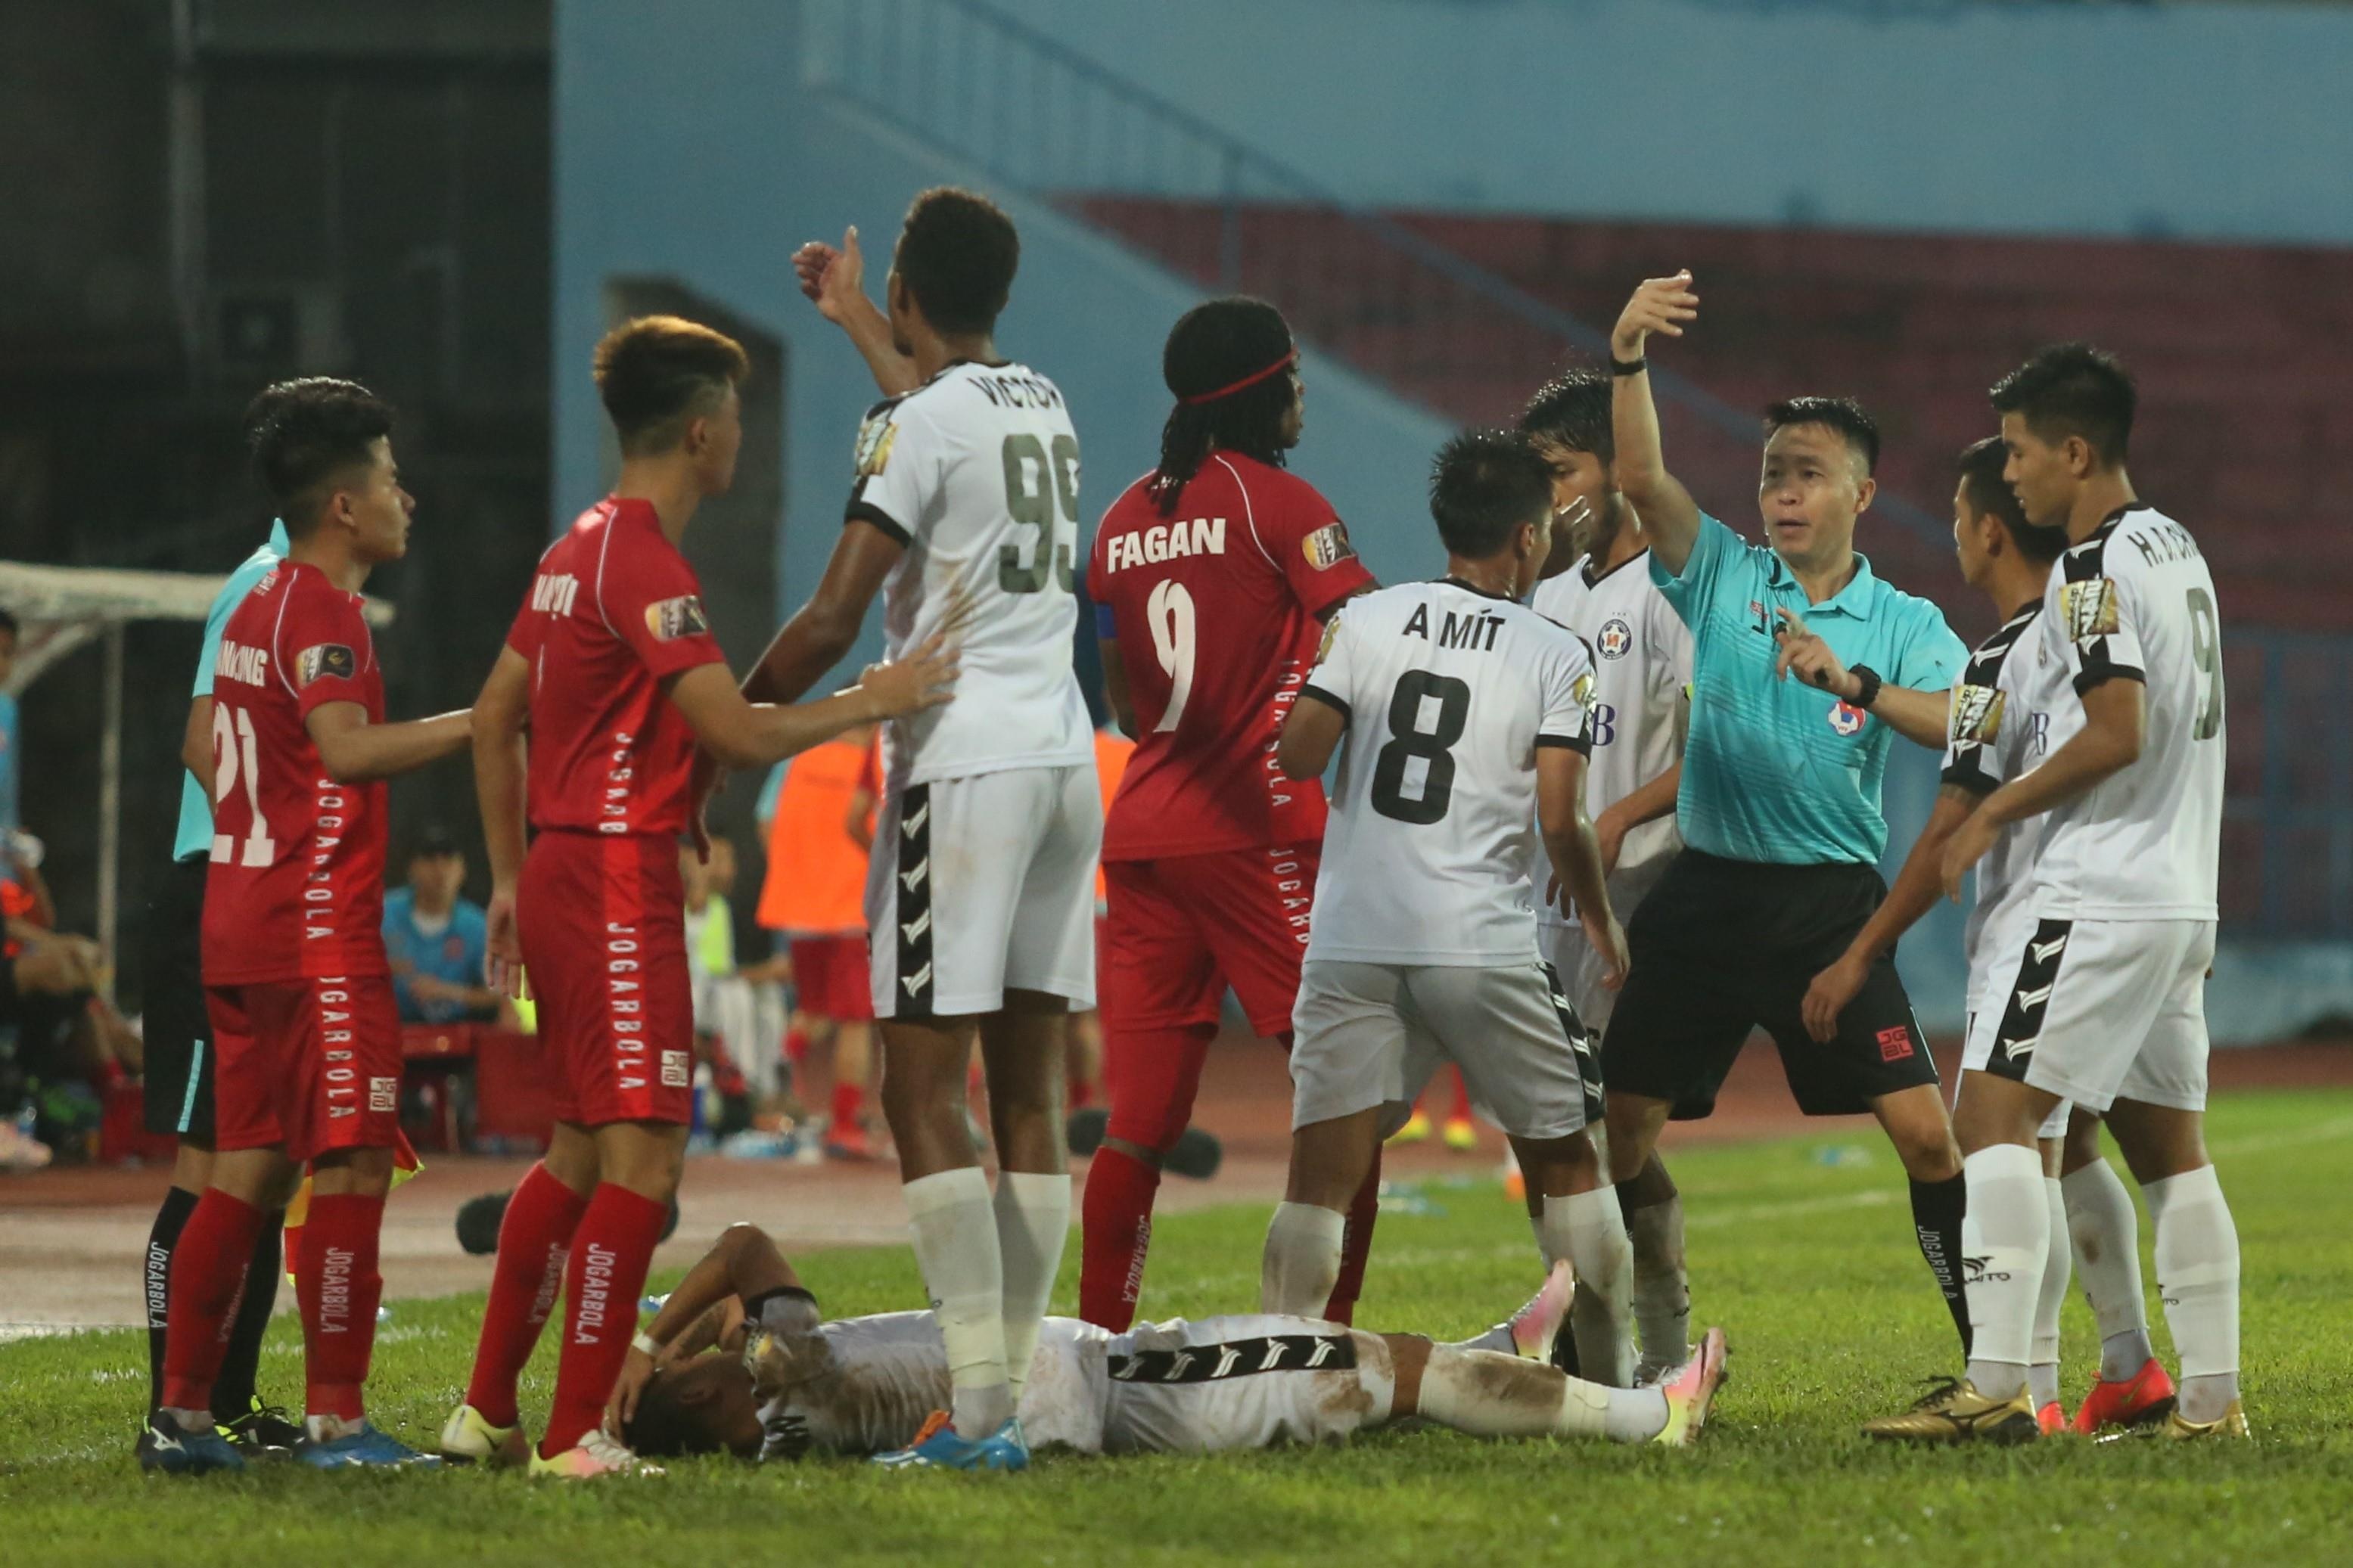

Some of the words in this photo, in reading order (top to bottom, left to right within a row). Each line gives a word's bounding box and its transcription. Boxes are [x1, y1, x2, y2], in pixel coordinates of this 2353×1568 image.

[998, 433, 1080, 594] 99
[1108, 517, 1226, 574] FAGAN
[1146, 579, 1196, 733] 9
[1403, 603, 1428, 640] A
[1439, 609, 1506, 652] MÍT
[2186, 587, 2221, 741] 9
[210, 701, 275, 868] 21
[1370, 669, 1470, 825] 8
[606, 922, 648, 1090] JOGARBOLA
[146, 1241, 170, 1329] JOGARBOLA
[320, 1247, 355, 1334] JOGARBOLA
[574, 1243, 617, 1345] JOGARBOLA
[1121, 1214, 1152, 1303] JOGARBOLA
[1917, 1225, 1958, 1300] JOGARBOLA
